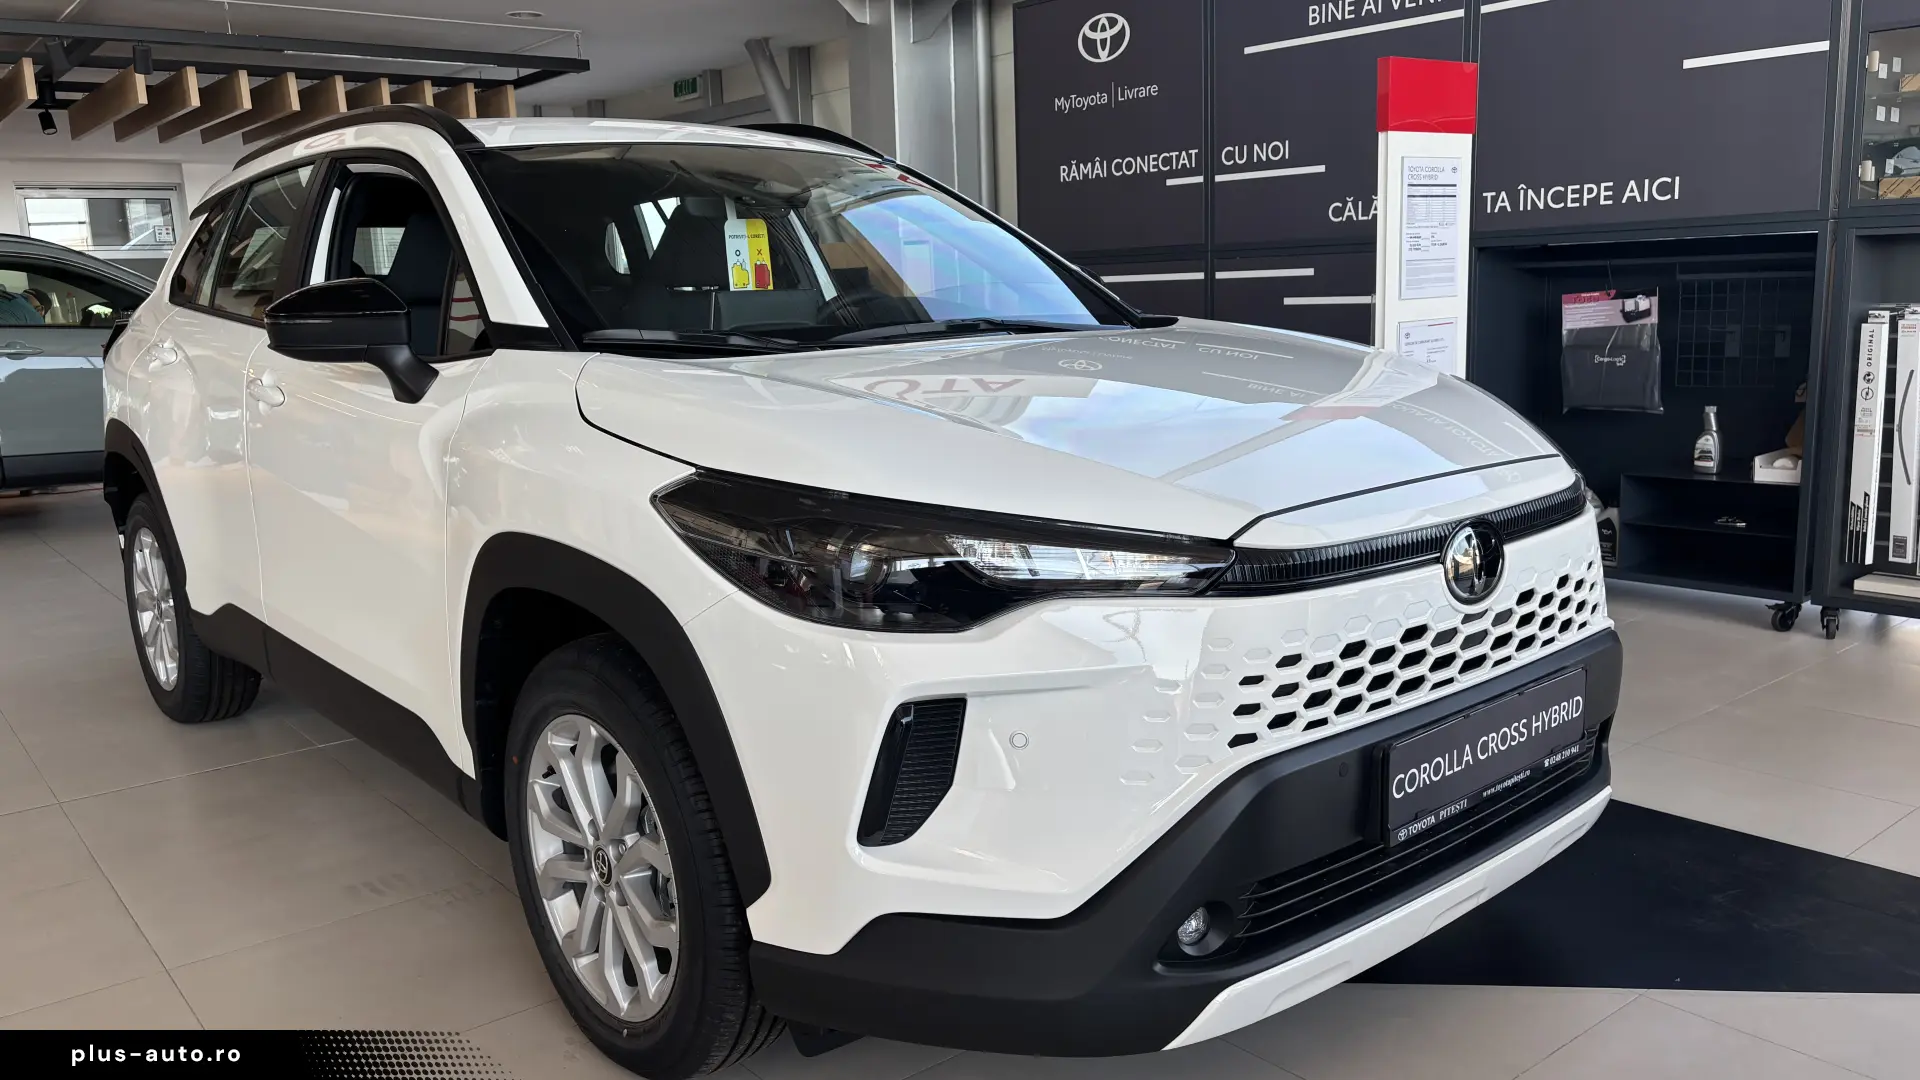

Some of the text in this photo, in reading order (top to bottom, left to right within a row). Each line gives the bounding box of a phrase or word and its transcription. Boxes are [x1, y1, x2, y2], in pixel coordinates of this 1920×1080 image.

[1308, 0, 1355, 26] BINE
[1054, 84, 1159, 113] MyToyota Livrare
[1060, 140, 1289, 183] RĂMÂI CONECTAT CU NOI
[1483, 191, 1512, 213] TA
[1518, 182, 1614, 211] ÎNCEPE
[1621, 176, 1680, 204] AICI
[1866, 328, 1875, 367] ORIGINAL
[1392, 695, 1583, 799] COROLLA CROSS HYBRID
[1408, 815, 1435, 836] TOYOTA
